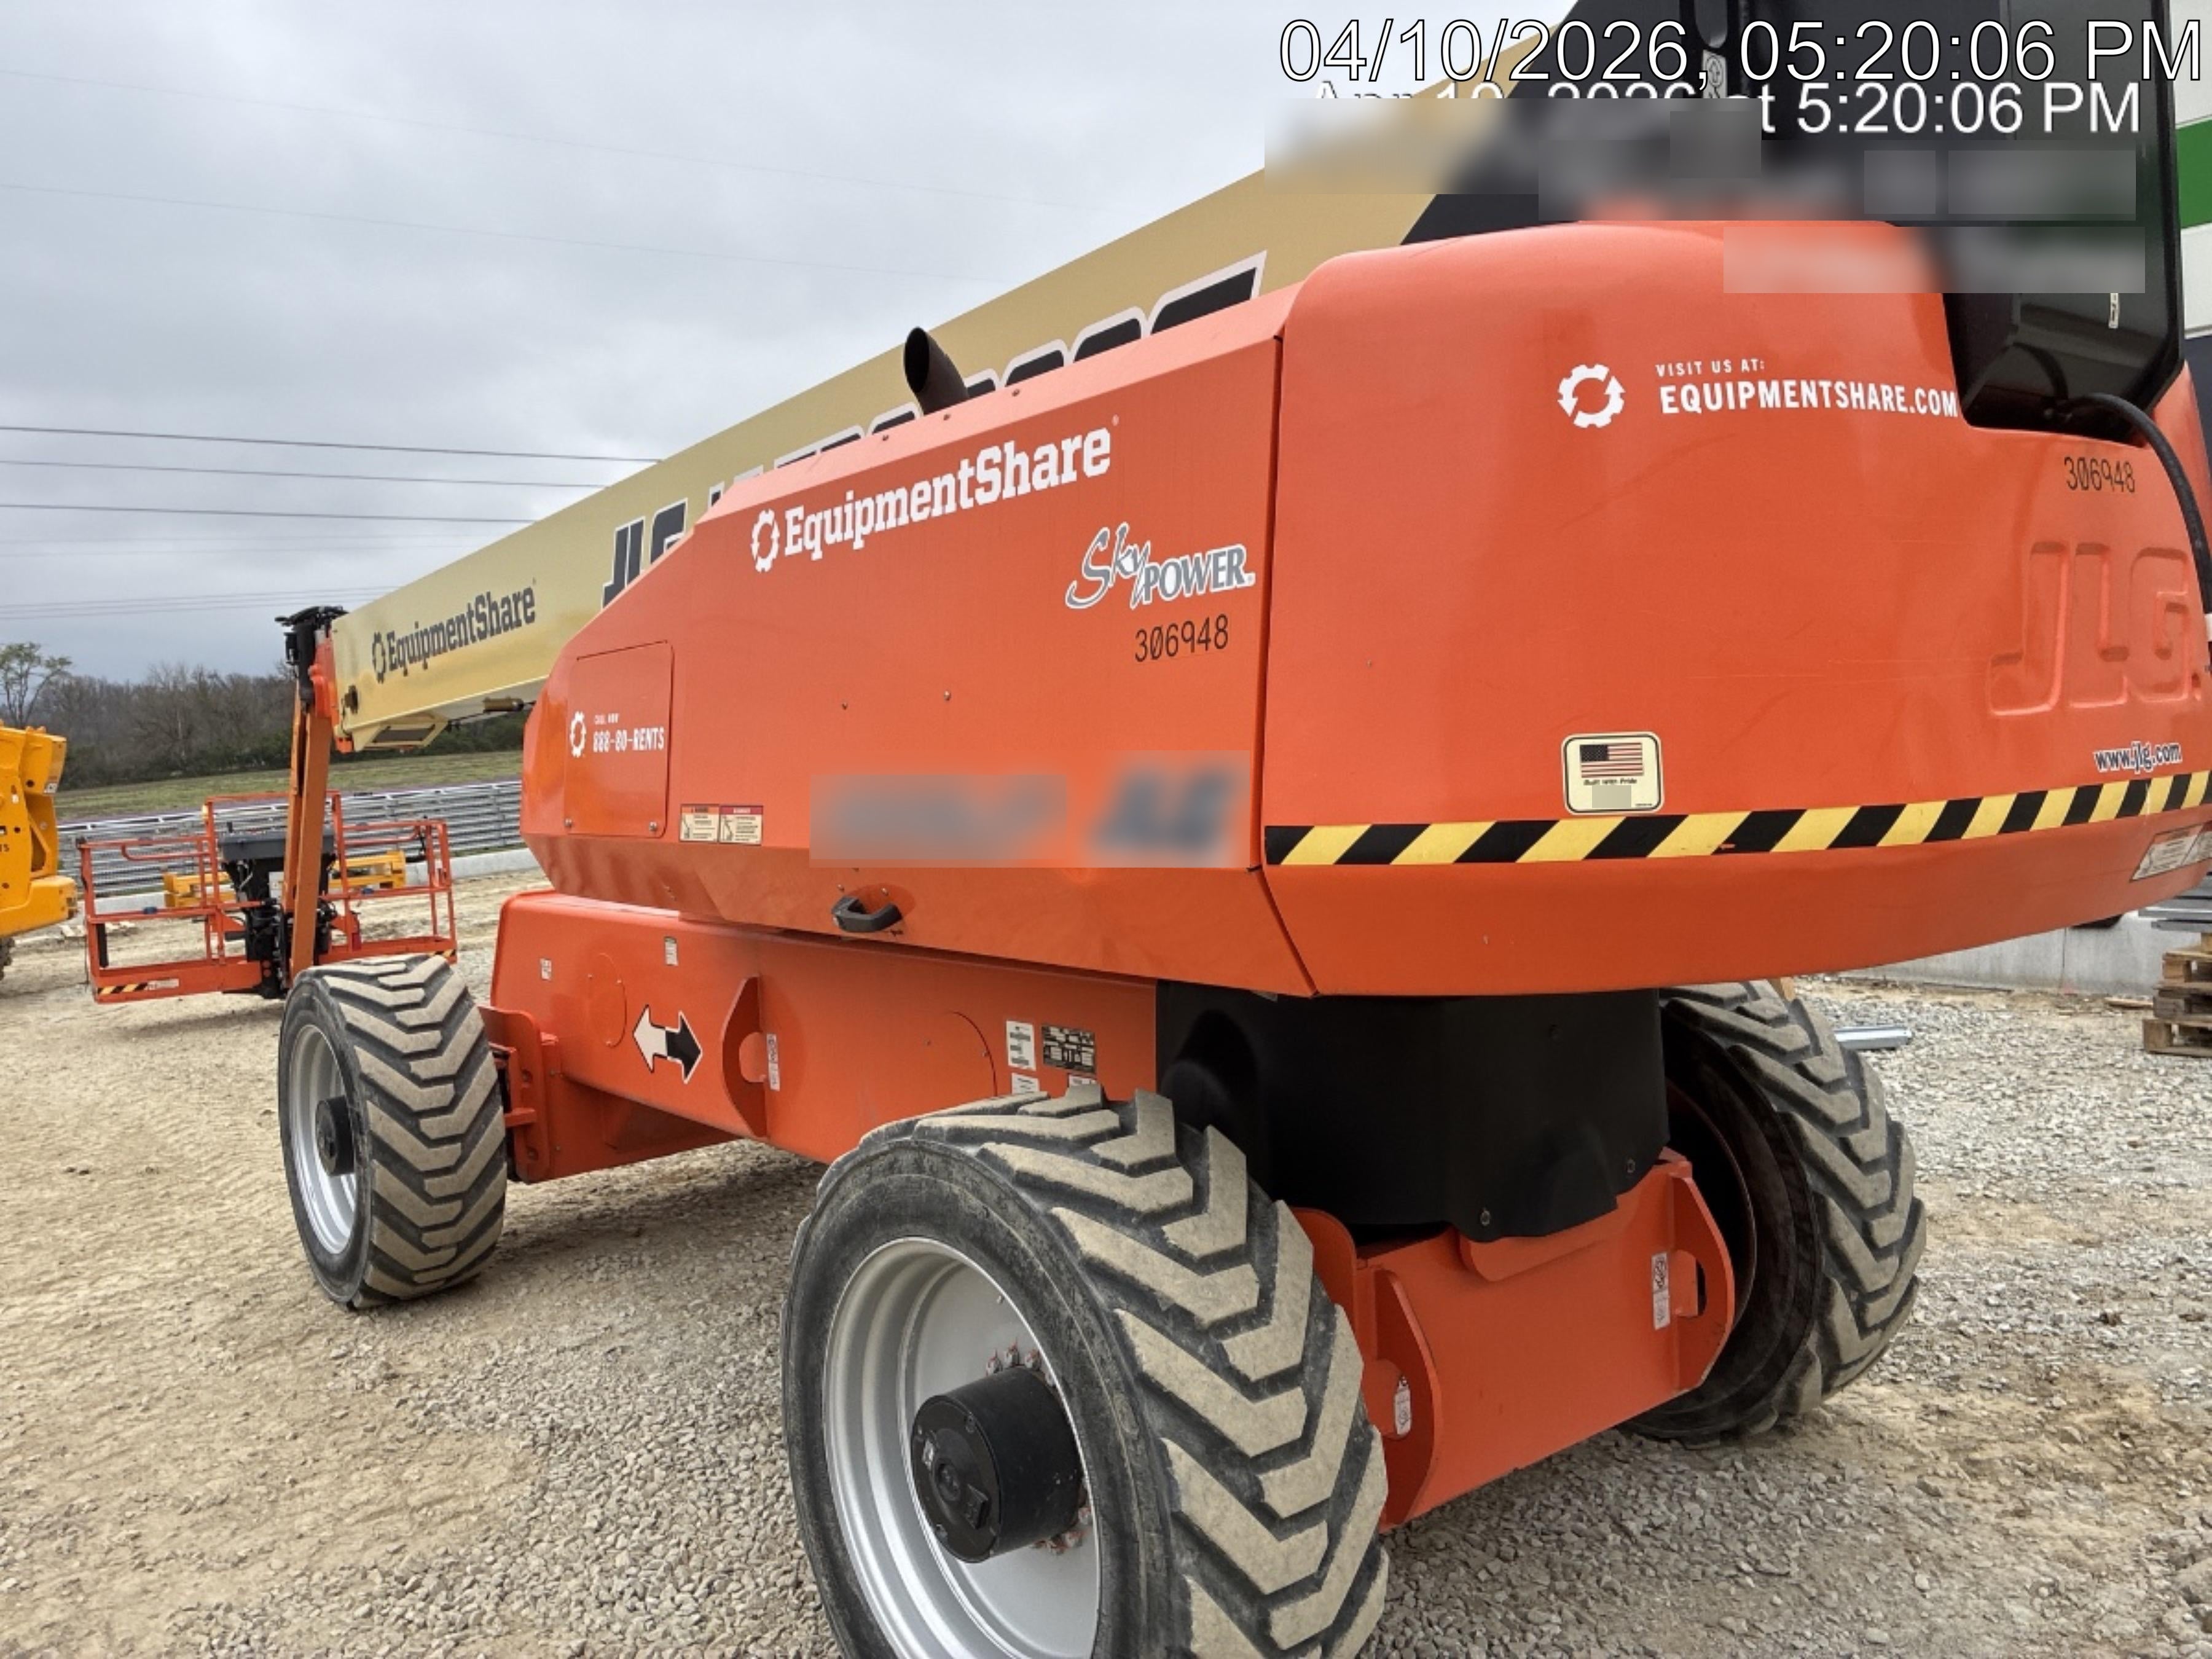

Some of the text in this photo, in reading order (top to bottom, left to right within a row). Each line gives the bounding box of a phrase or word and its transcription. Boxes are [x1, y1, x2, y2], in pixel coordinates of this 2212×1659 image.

[1656, 358, 1765, 377] VISIT US AT:
[1660, 379, 1958, 418] EQUIPMENTSHARE.COM
[784, 427, 1111, 560] EquipmentShare
[2065, 456, 2135, 493] 306948
[1065, 522, 1247, 610] Sky POWER
[387, 587, 536, 677] EquipmentShare
[1134, 613, 1229, 662] 306948
[2093, 741, 2181, 774] www.jlg.com
